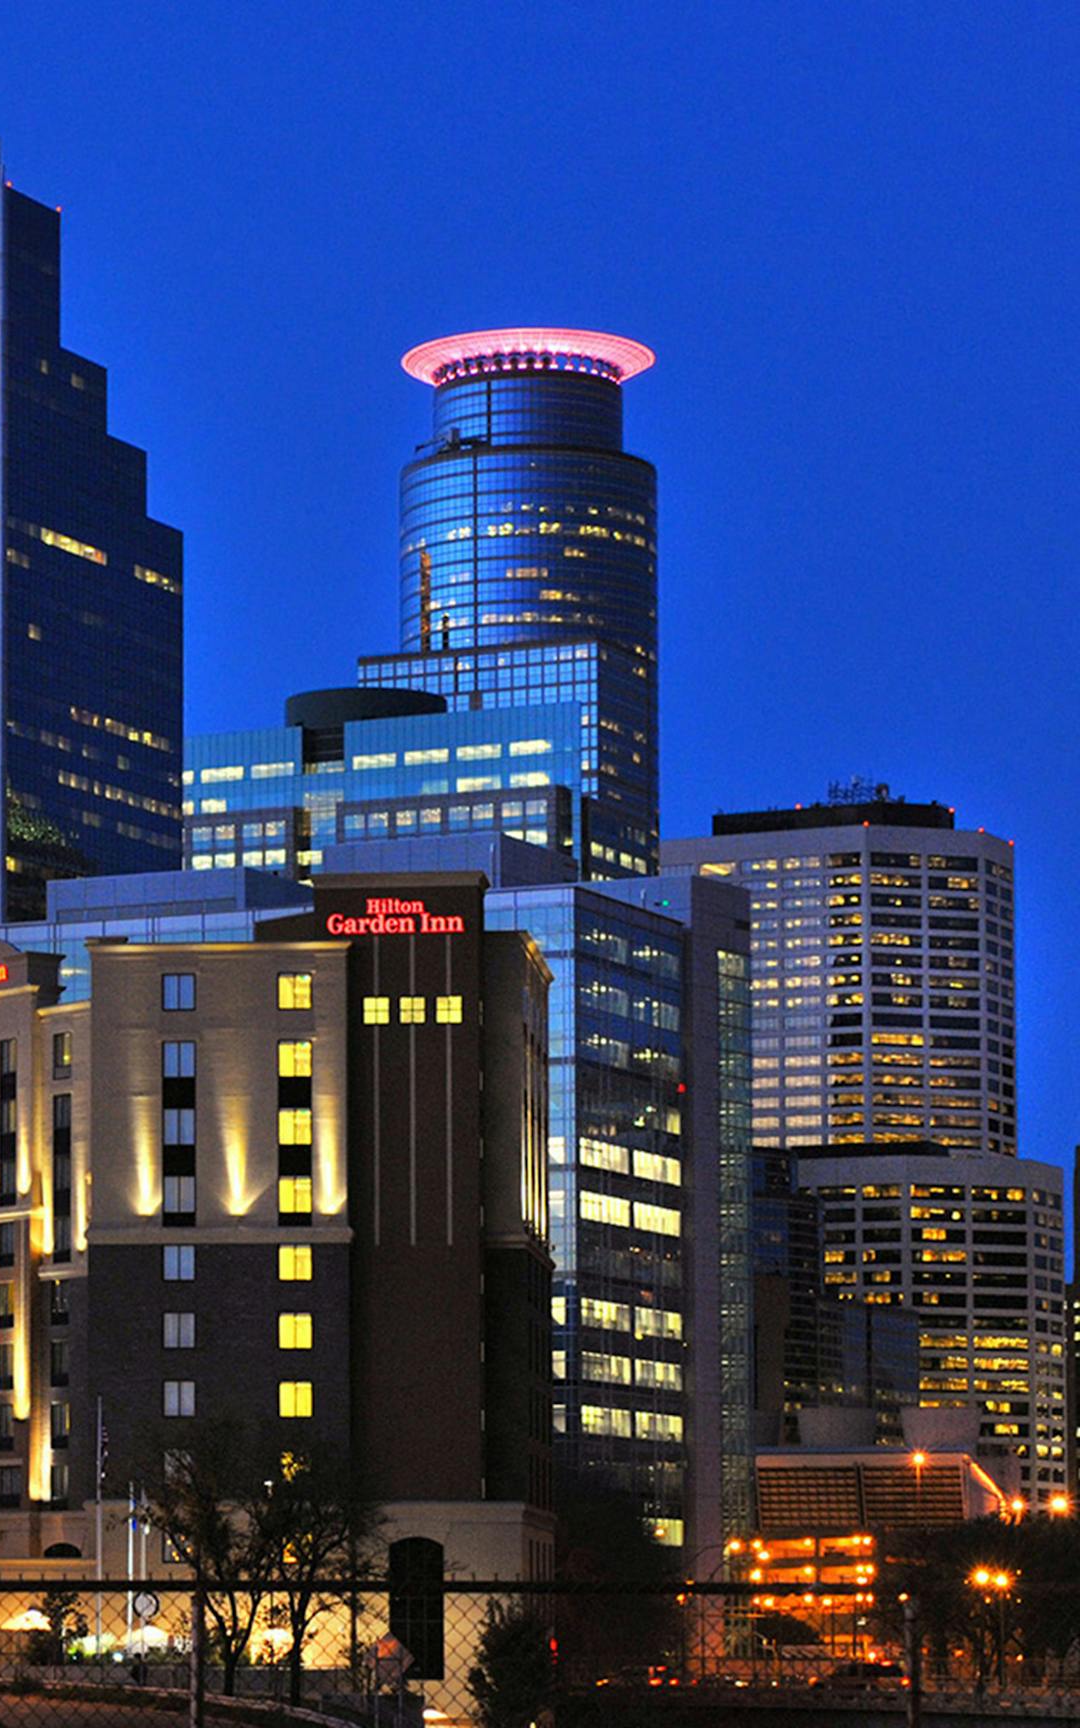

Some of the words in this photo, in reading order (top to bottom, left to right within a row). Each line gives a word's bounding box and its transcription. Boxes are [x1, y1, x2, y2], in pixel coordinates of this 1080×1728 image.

[366, 899, 425, 914] Hilton
[326, 913, 416, 935] Garden
[420, 912, 465, 933] Inn
